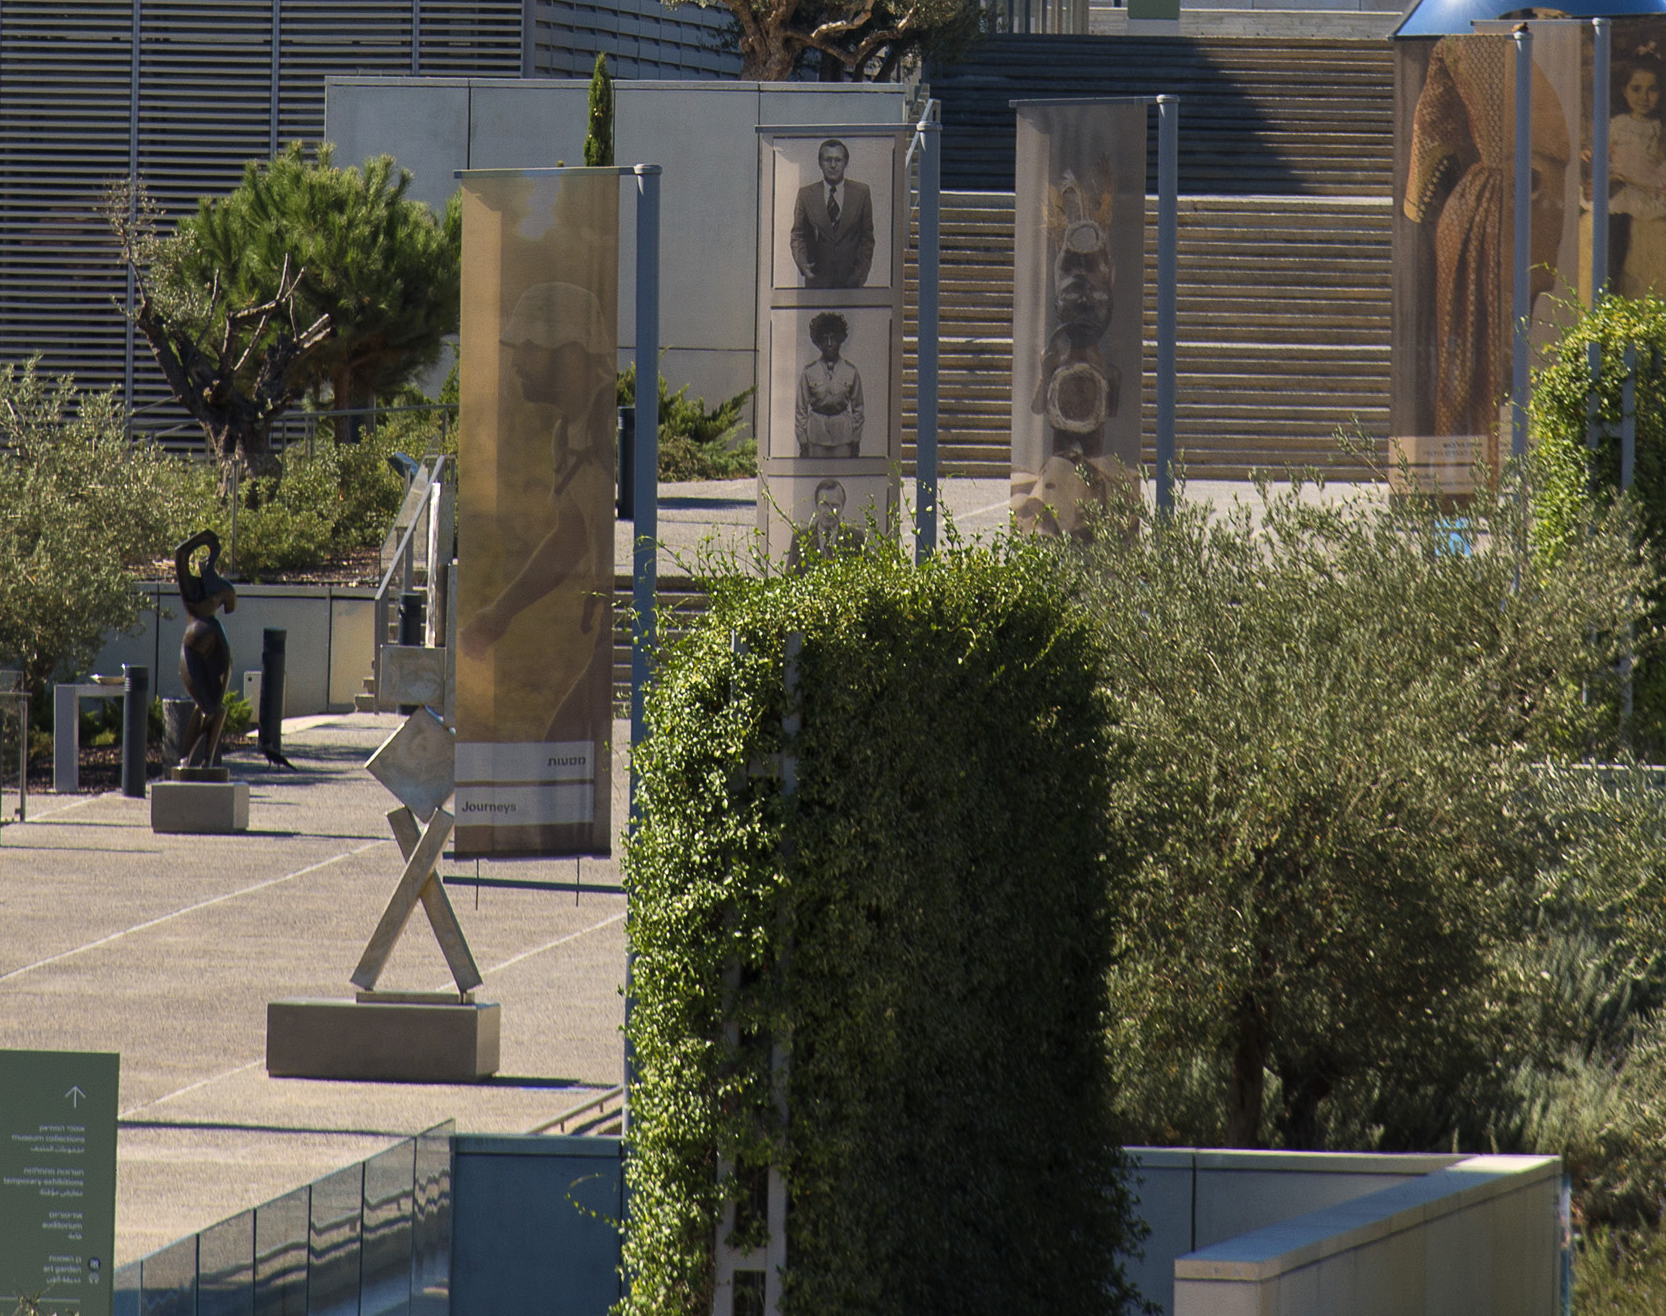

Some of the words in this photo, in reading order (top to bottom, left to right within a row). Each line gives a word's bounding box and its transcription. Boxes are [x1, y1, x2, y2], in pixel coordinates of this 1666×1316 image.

[547, 756, 586, 767] מסעות
[462, 801, 516, 815] Journeys
[12, 1134, 44, 1142] museum
[45, 1134, 85, 1143] collections
[3, 1177, 42, 1187] temporary
[43, 1177, 84, 1186] exhibitions
[42, 1221, 82, 1230] auditorium
[43, 1265, 53, 1273] art
[55, 1265, 82, 1275] garden
